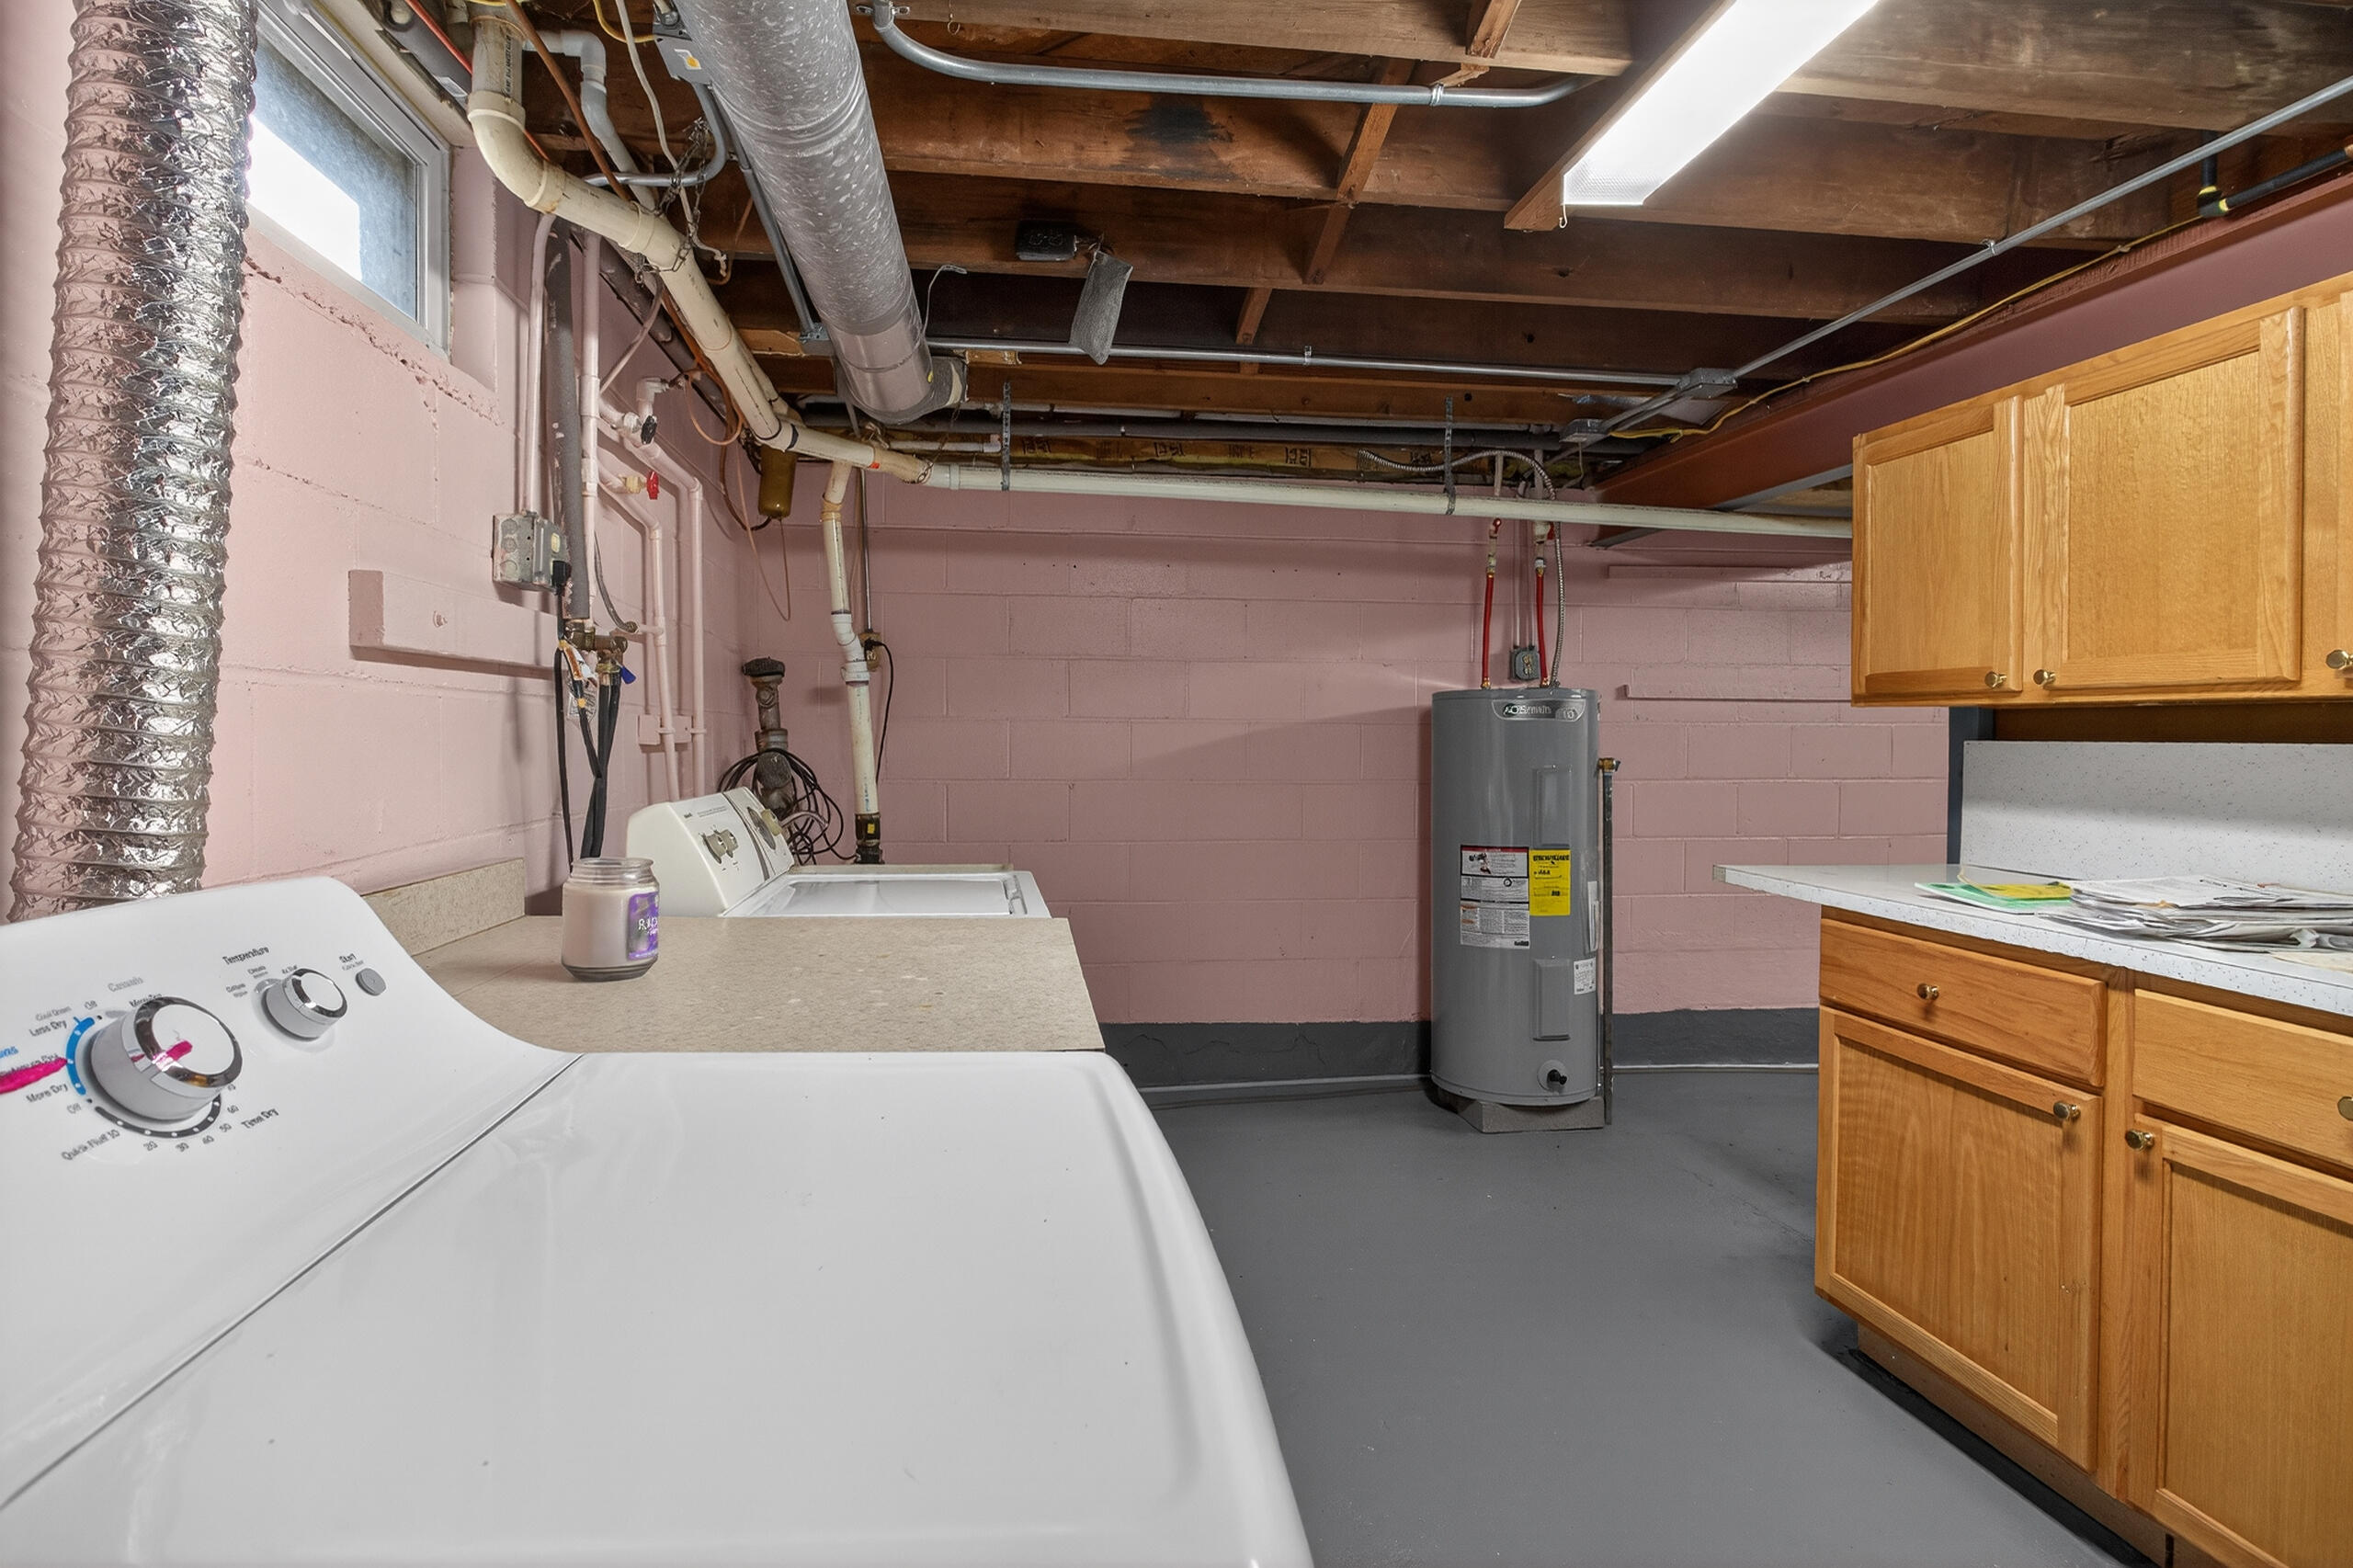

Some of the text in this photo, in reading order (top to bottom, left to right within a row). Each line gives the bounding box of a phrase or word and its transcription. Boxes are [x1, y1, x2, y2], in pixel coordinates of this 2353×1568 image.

[222, 947, 269, 965] Temperature
[50, 1018, 68, 1031] Dry
[26, 1083, 69, 1103] More Dry
[241, 1108, 279, 1129] Time Dry
[61, 1143, 88, 1161] Quick
[143, 1141, 159, 1152] 20
